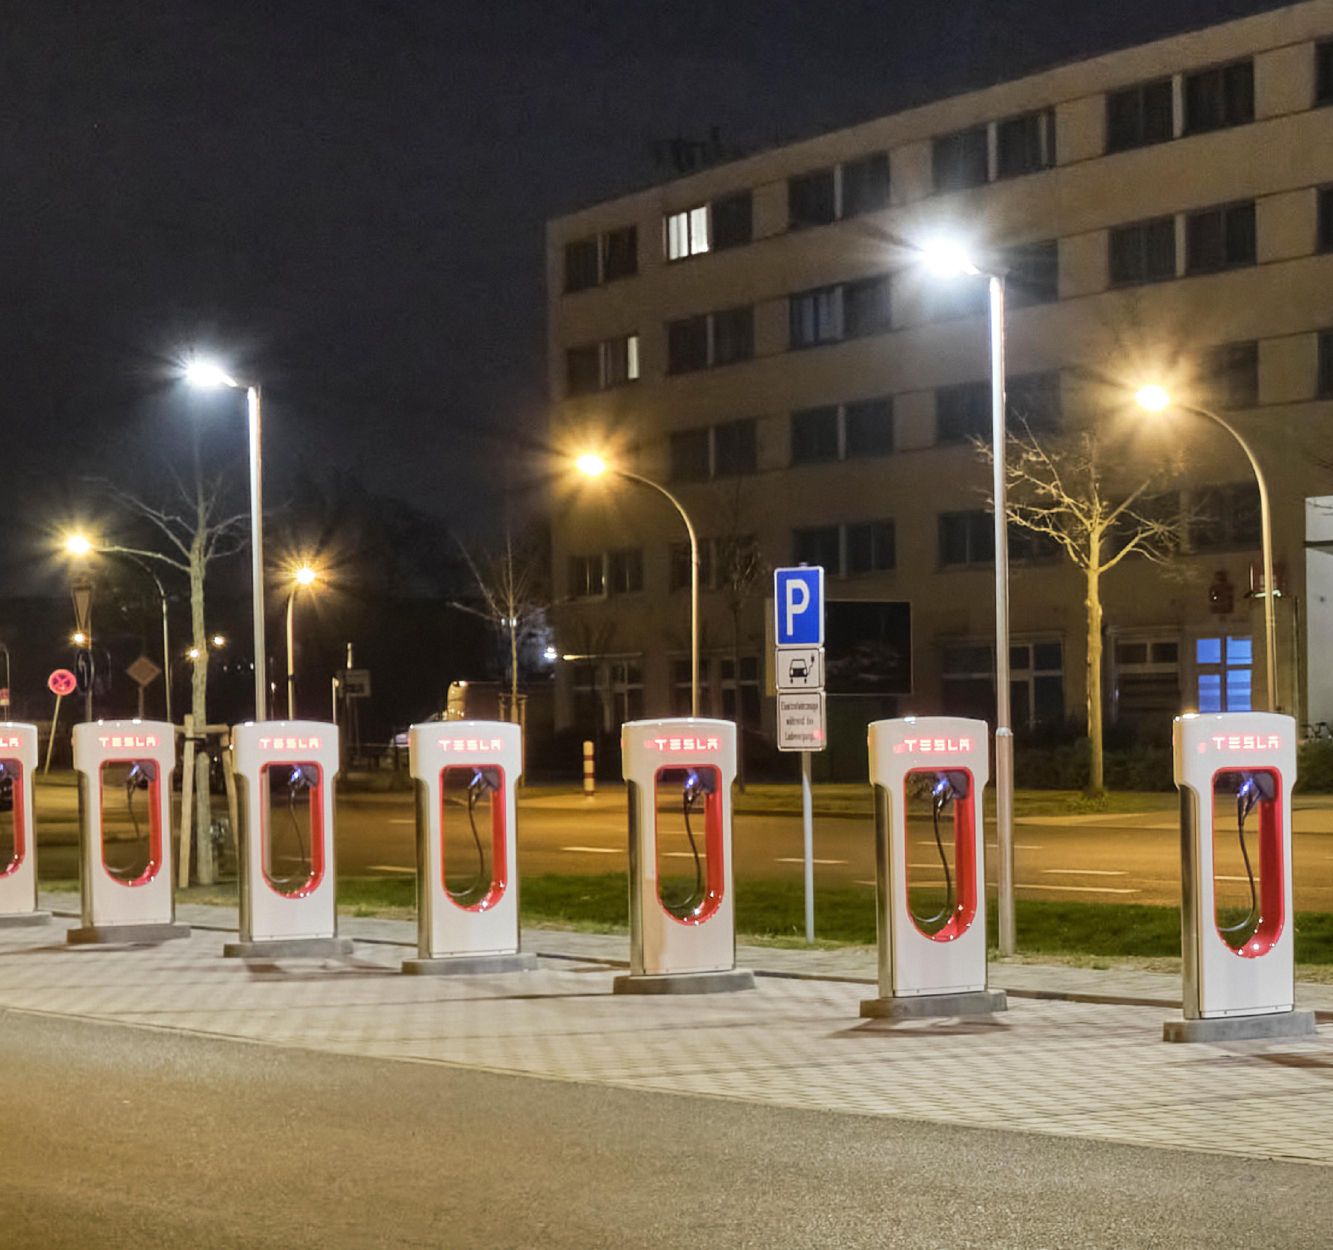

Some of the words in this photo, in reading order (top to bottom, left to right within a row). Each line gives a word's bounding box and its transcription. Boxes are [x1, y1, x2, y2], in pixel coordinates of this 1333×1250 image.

[786, 579, 810, 636] P
[99, 736, 157, 747] TESLA
[259, 737, 319, 749] TESLA
[438, 739, 501, 751] TESLA
[654, 738, 718, 750] TESLA
[904, 738, 970, 751] TESLA
[1212, 736, 1279, 750] TESLA
